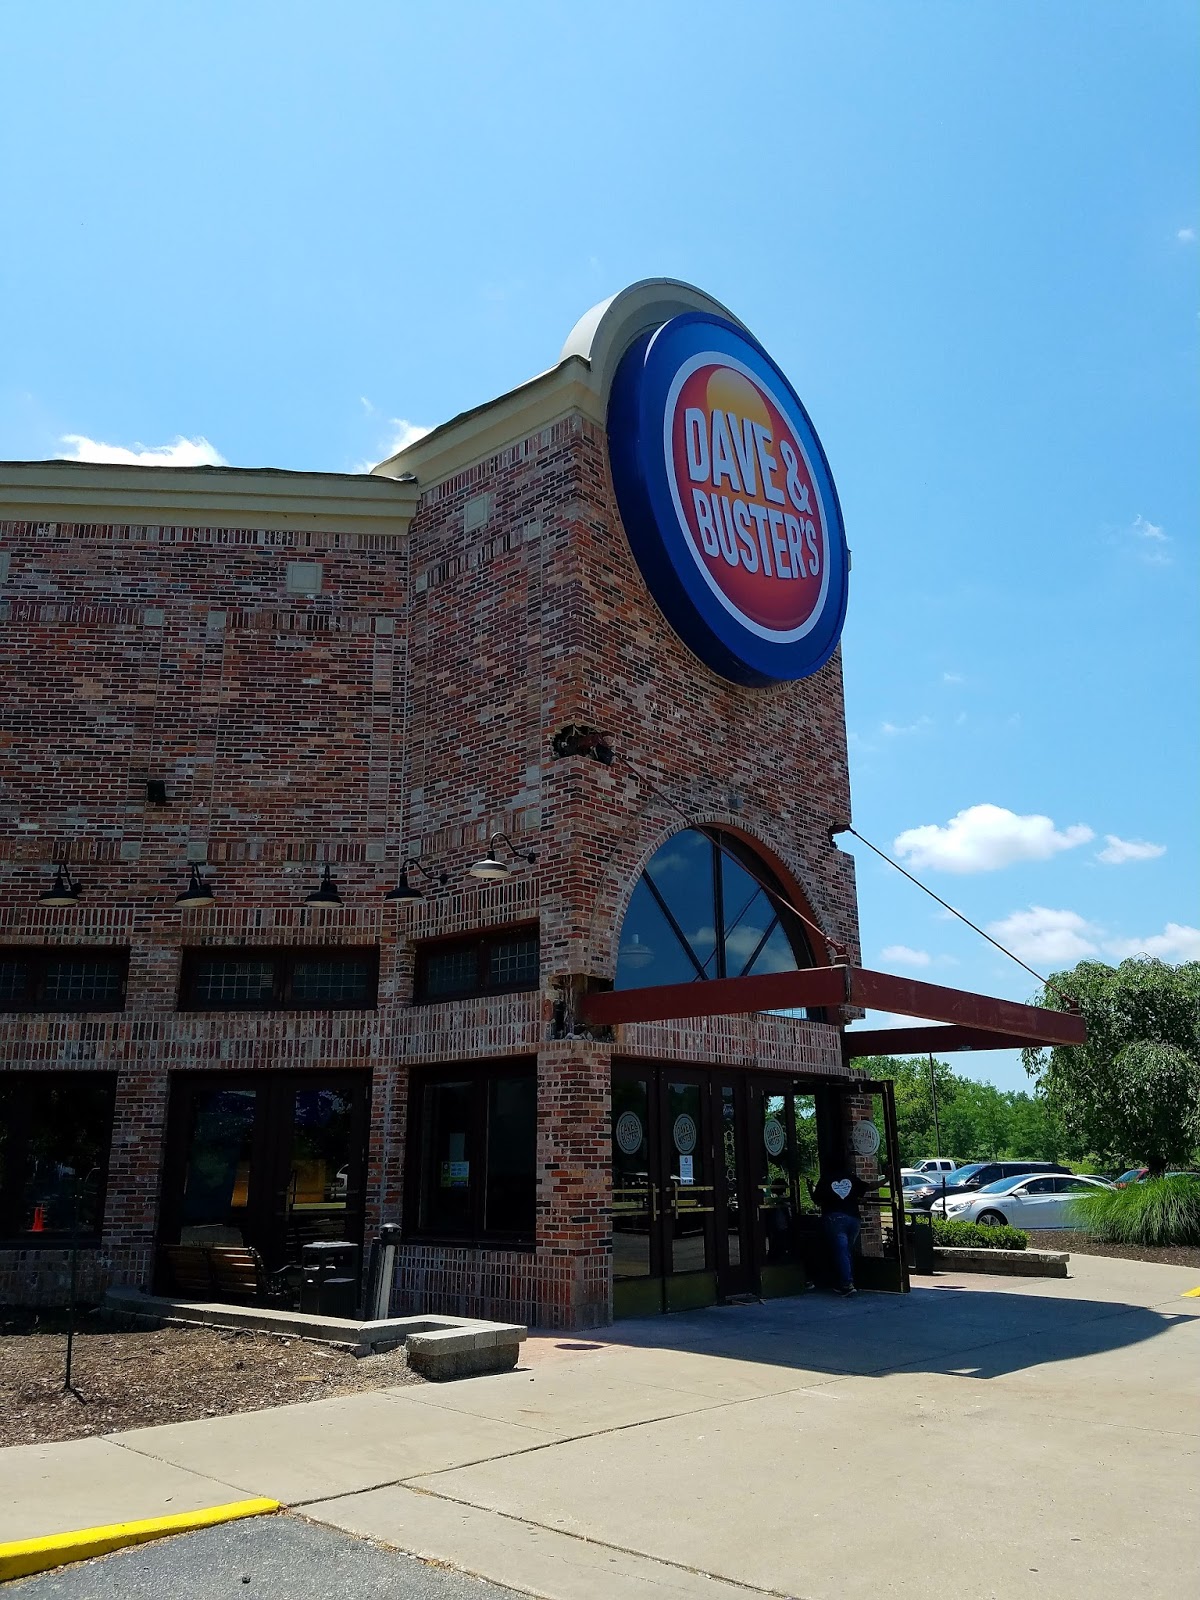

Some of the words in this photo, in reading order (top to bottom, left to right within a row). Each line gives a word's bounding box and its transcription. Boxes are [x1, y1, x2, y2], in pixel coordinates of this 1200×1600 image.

[685, 408, 785, 506] DAVE
[779, 440, 813, 516] &
[692, 487, 820, 580] BUSTER'S
